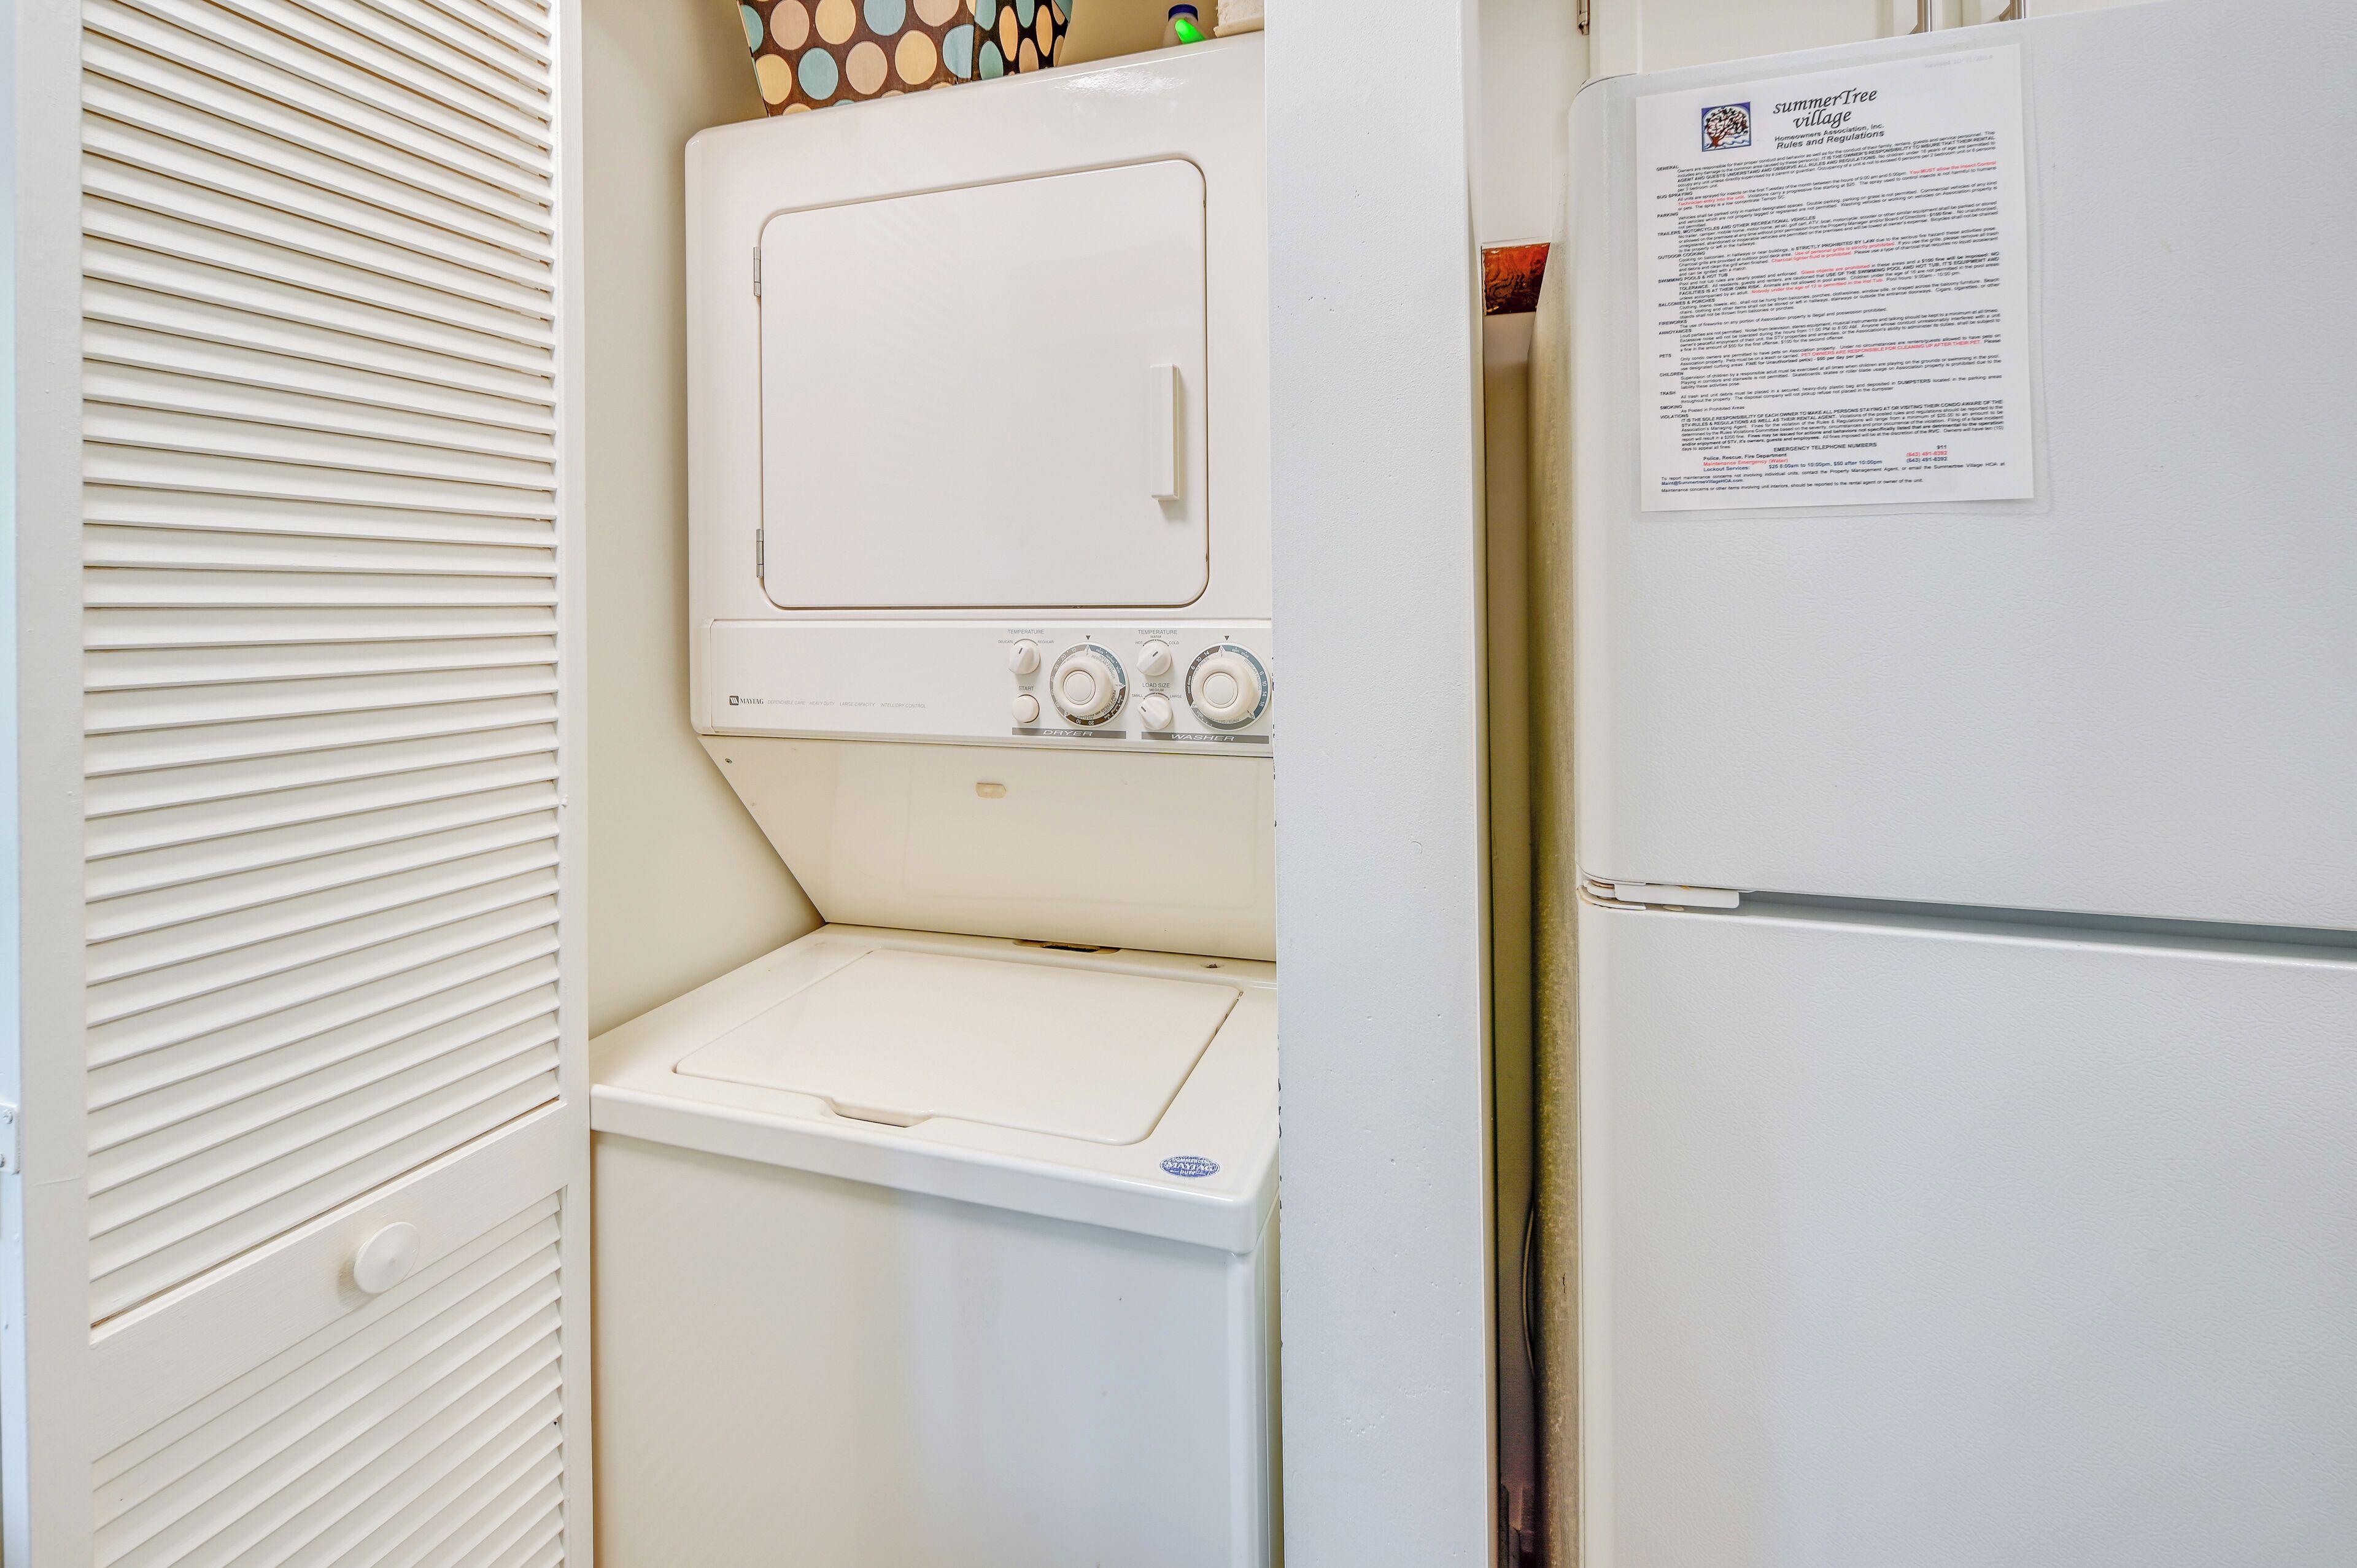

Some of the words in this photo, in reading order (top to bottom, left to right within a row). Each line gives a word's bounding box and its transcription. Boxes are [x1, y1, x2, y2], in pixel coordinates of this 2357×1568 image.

[1773, 87, 1877, 114] summerTree
[1793, 108, 1851, 129] village
[1774, 130, 1821, 142] Homeowners
[1823, 124, 1869, 136] Association,
[1776, 139, 1802, 149] Rules
[1806, 137, 1824, 146] and
[1826, 129, 1884, 144] Regulations
